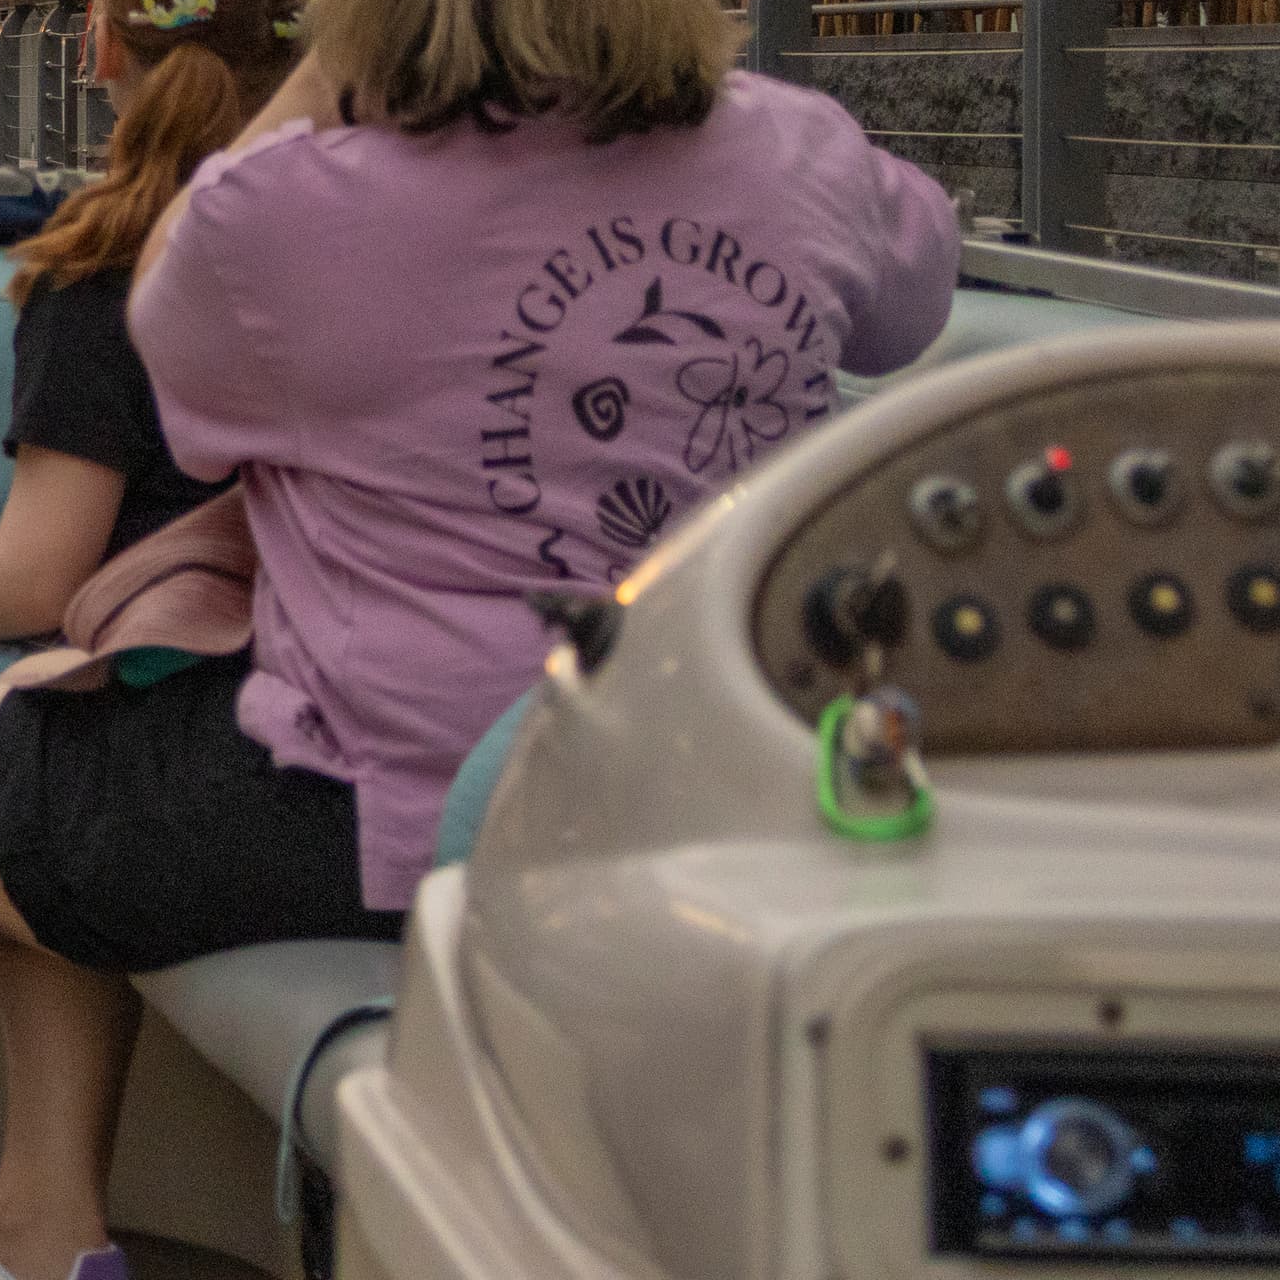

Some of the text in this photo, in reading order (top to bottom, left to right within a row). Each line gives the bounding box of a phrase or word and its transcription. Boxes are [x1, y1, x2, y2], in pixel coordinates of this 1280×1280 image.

[480, 216, 830, 516] CHANGE IS GROW
